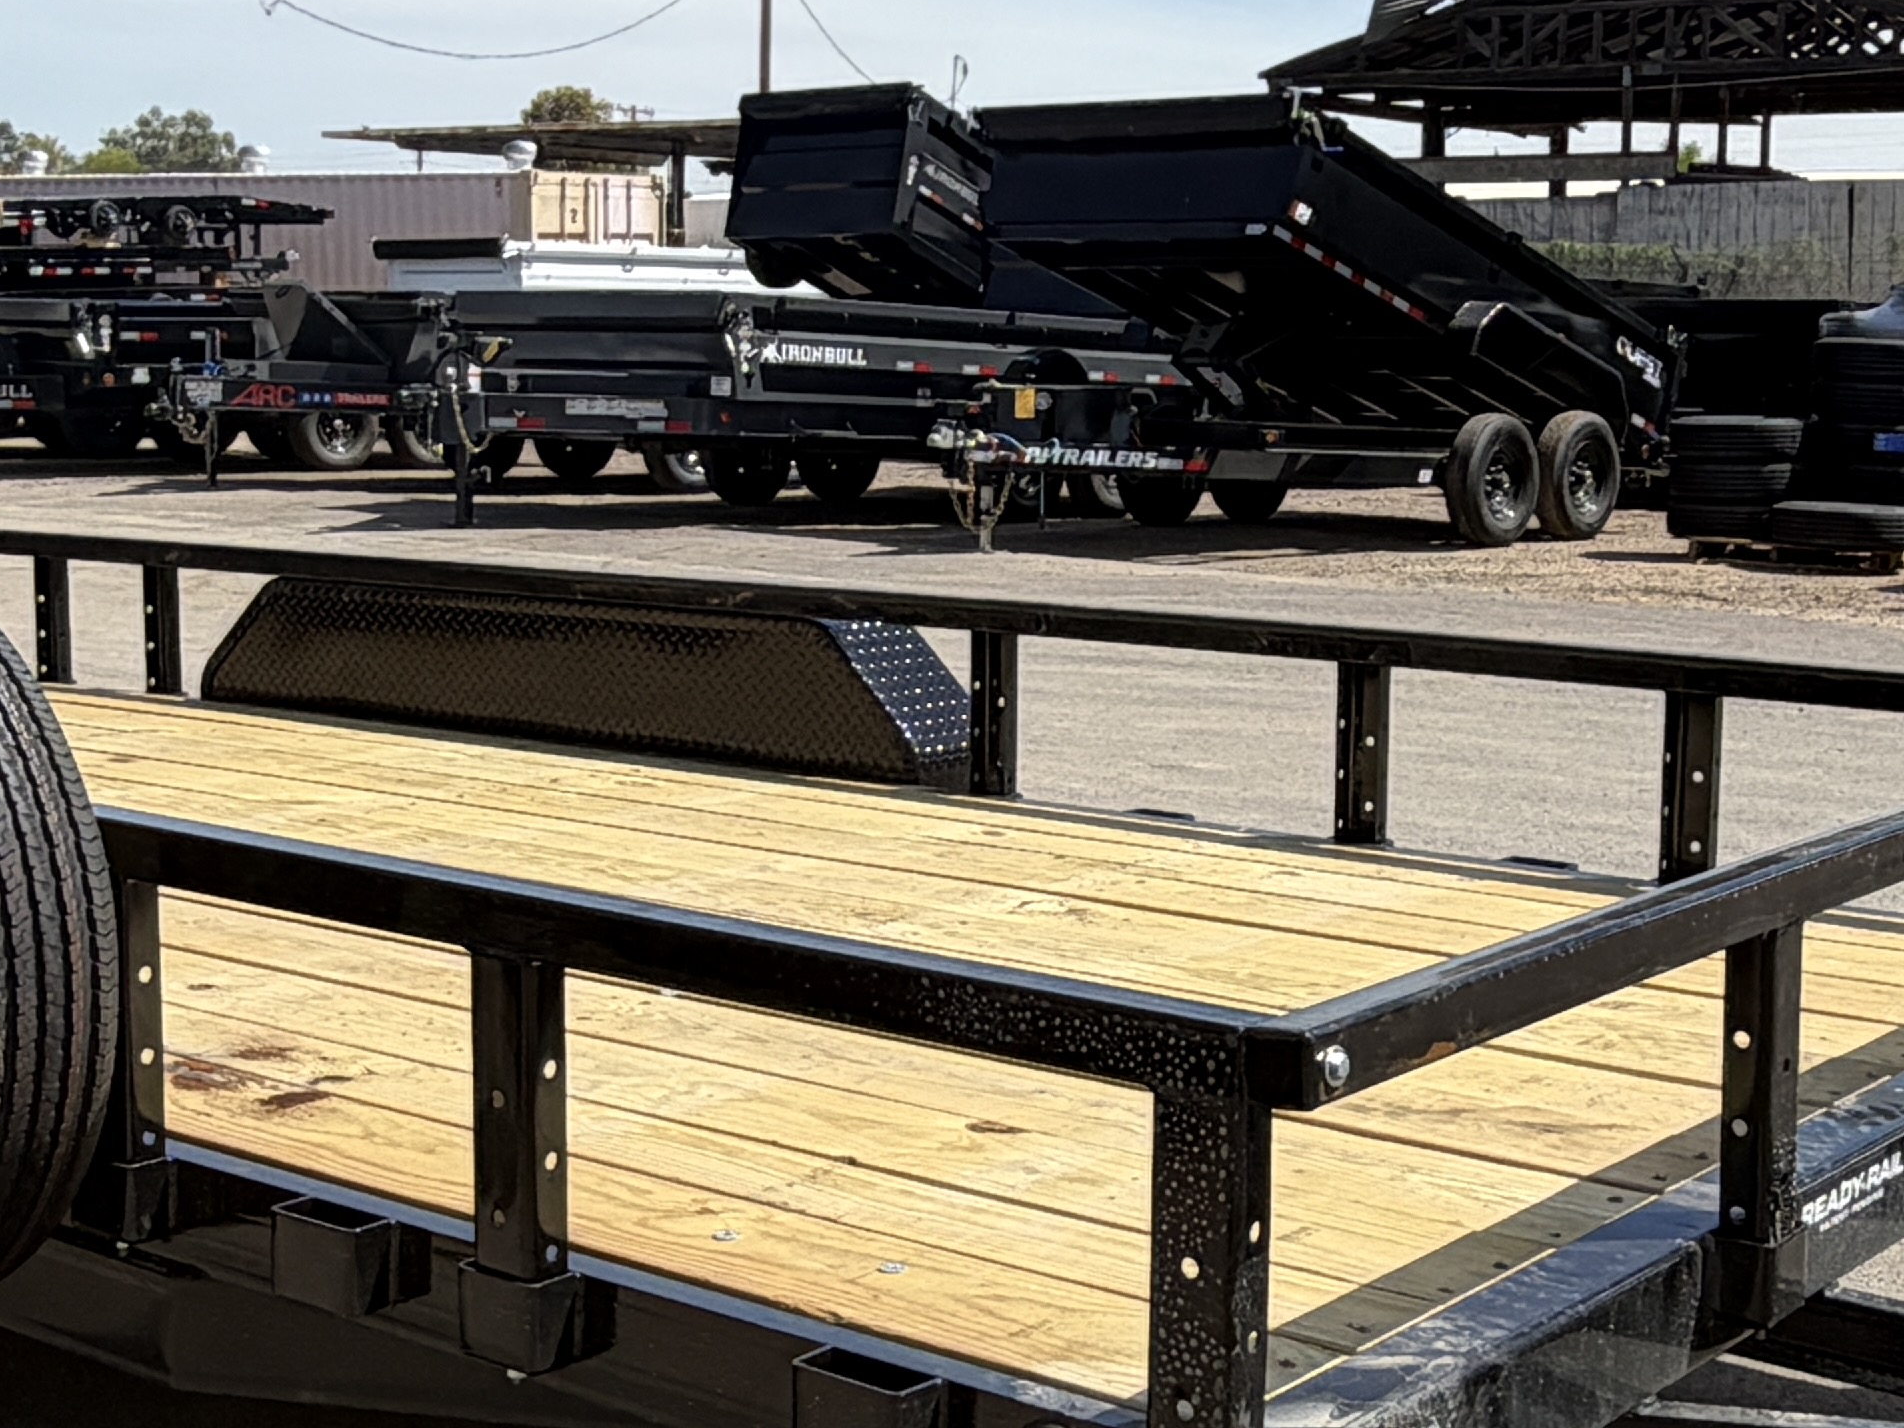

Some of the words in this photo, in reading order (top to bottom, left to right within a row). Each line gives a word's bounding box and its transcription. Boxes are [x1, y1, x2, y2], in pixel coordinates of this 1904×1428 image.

[781, 342, 868, 366] IRONBULL
[230, 383, 296, 408] ARC
[1049, 448, 1159, 469] TRAILERS
